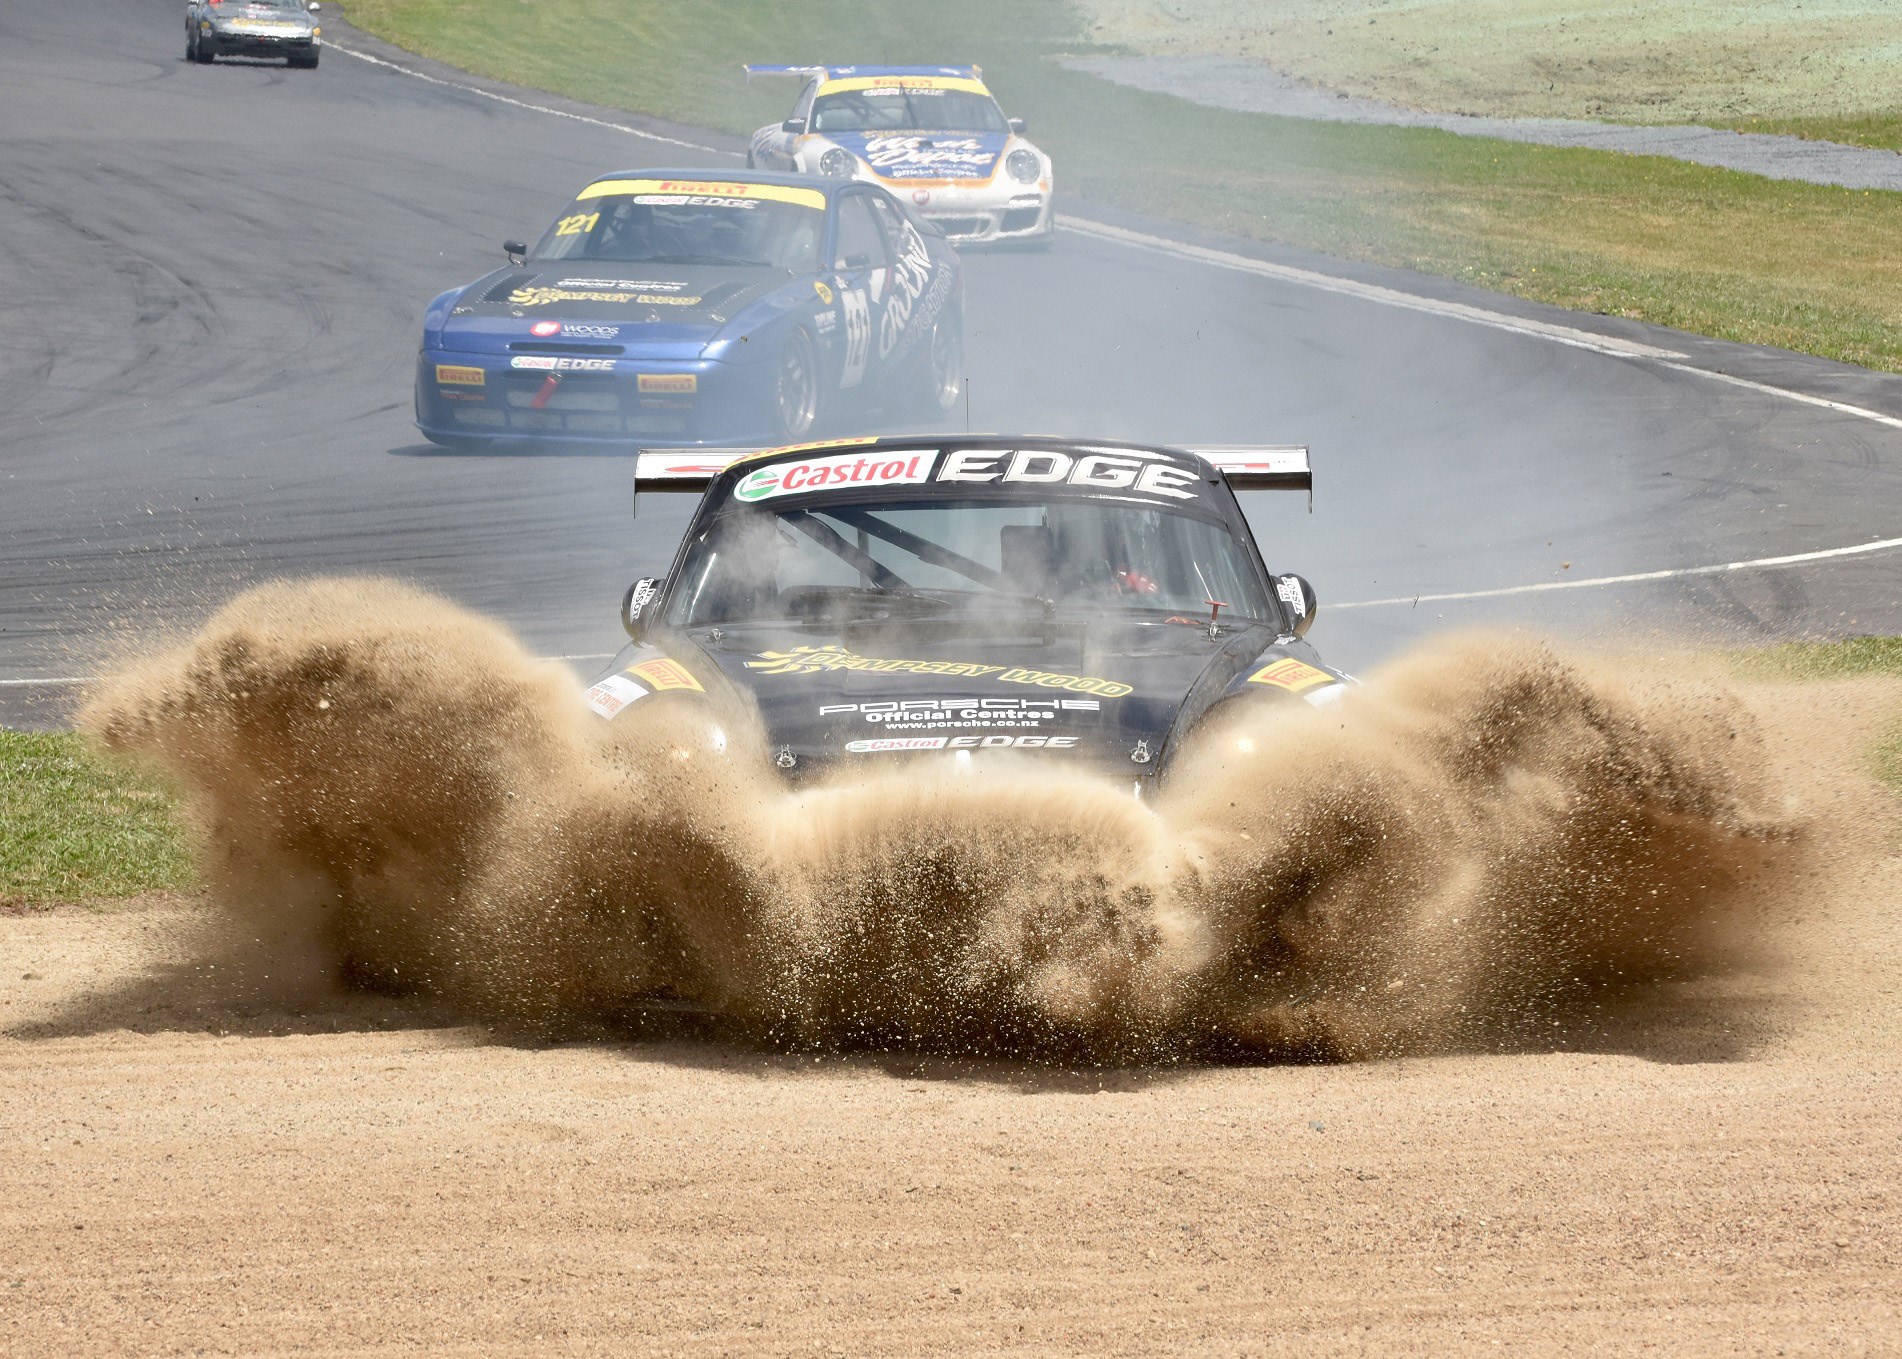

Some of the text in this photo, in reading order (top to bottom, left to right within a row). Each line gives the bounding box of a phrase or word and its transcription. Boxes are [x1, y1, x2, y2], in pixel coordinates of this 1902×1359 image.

[555, 213, 601, 237] 121
[556, 358, 617, 371] EDGE
[782, 449, 1200, 500] Castrol EDGE
[632, 579, 651, 619] TISSOT
[998, 666, 1133, 698] WOOD
[819, 698, 1100, 716] PORSCHE
[865, 708, 1055, 723] Official Centres
[885, 719, 1040, 730] www.porsche.co.nz
[870, 735, 1082, 750] Castrol EDGE
